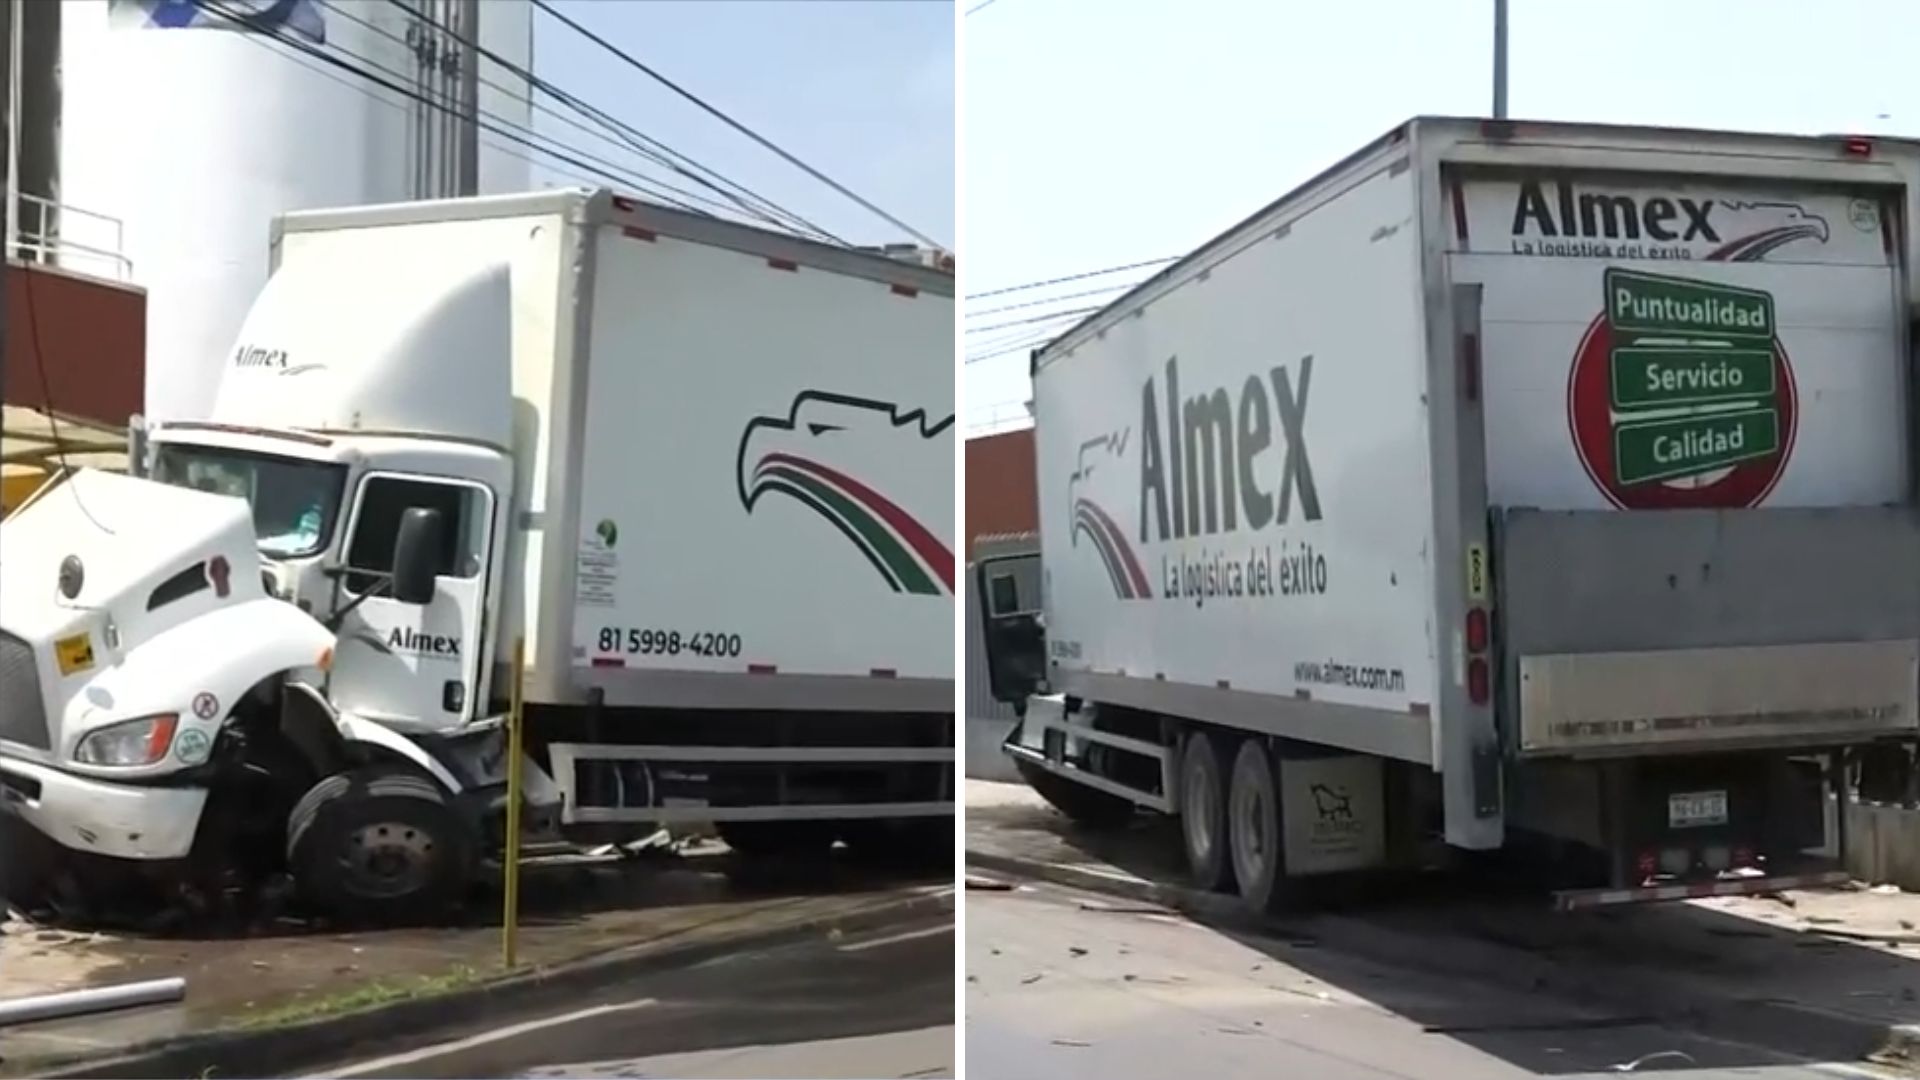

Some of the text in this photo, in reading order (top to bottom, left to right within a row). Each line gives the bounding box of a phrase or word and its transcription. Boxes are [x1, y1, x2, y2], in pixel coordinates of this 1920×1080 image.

[1511, 180, 1721, 243] Almex
[1512, 239, 1534, 256] La
[1616, 243, 1645, 260] del
[1616, 288, 1766, 328] Puntualidad
[235, 343, 289, 368] Almex
[1646, 361, 1743, 391] Servicio
[1139, 354, 1323, 544] Almex
[1653, 423, 1744, 464] Calidad
[1162, 555, 1179, 599] La
[1247, 545, 1274, 597] del
[1280, 538, 1327, 595] éxito
[387, 625, 461, 654] Almex
[599, 627, 741, 658] 81 5998-4200
